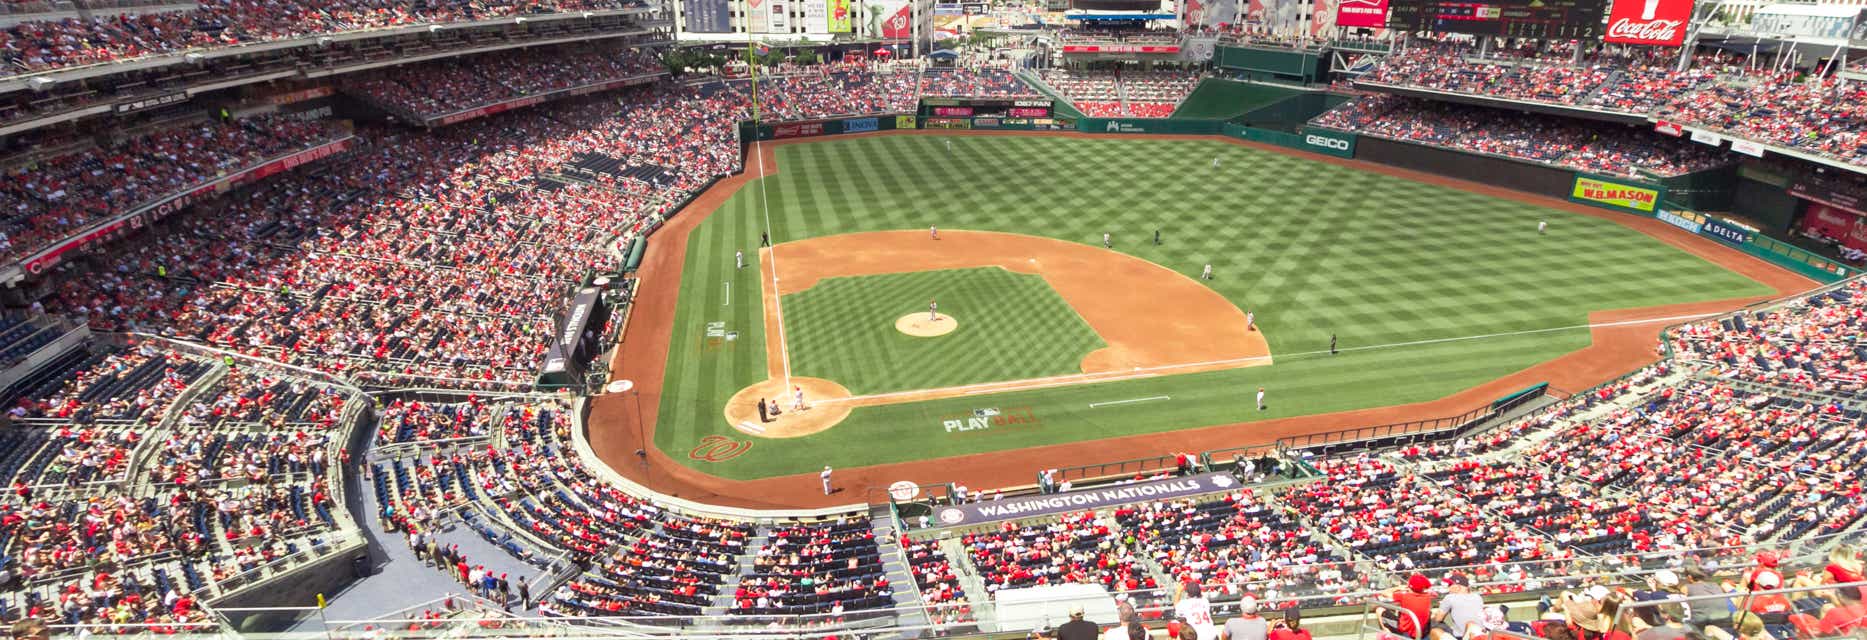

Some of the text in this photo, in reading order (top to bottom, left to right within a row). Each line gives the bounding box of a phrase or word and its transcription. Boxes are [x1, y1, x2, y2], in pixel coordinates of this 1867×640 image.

[1609, 18, 1683, 40] Coca-Cola
[1306, 134, 1349, 150] GEICO
[1713, 225, 1743, 242] DELTA
[943, 417, 989, 432] PLAY
[978, 479, 1200, 517] WASHINGTON NATIONALS
[1192, 611, 1210, 624] 34
